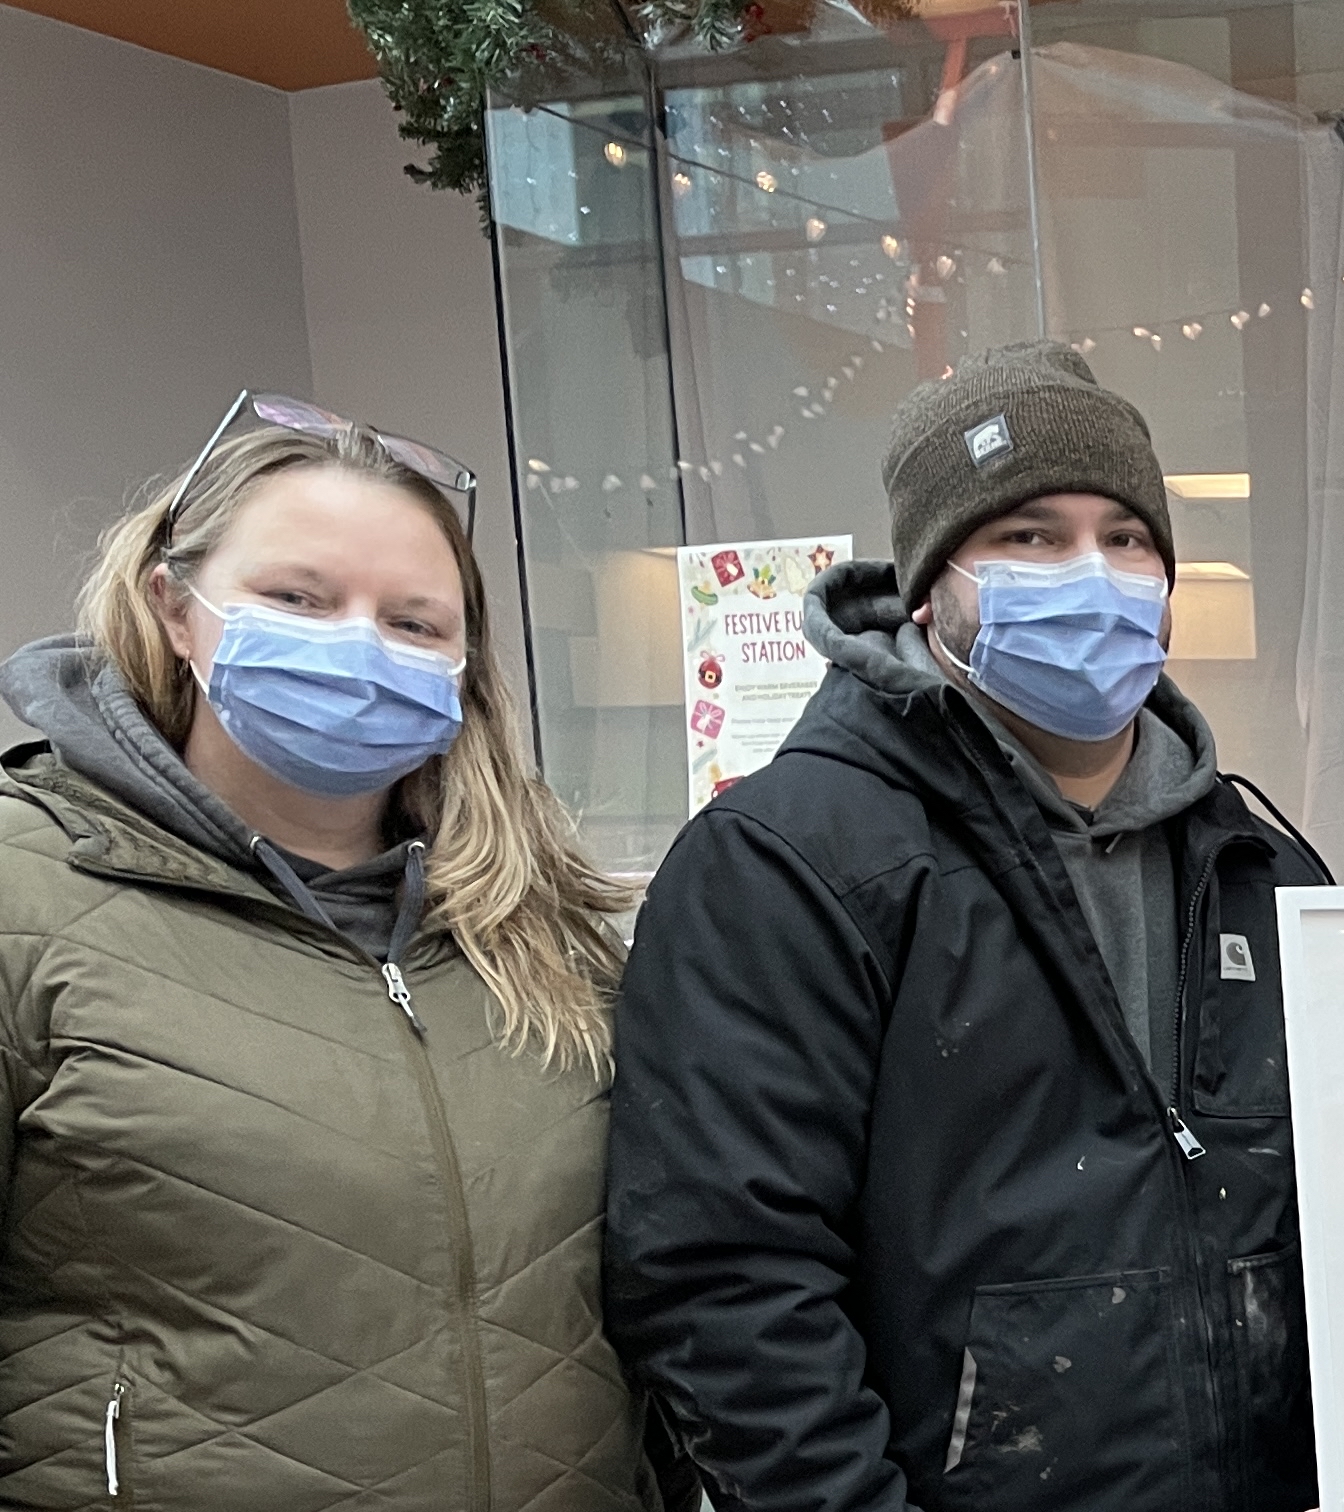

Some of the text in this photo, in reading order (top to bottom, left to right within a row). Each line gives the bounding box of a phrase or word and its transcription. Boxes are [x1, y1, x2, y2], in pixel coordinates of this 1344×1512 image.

[725, 610, 803, 635] FESTIVE FU
[742, 640, 806, 663] STATION
